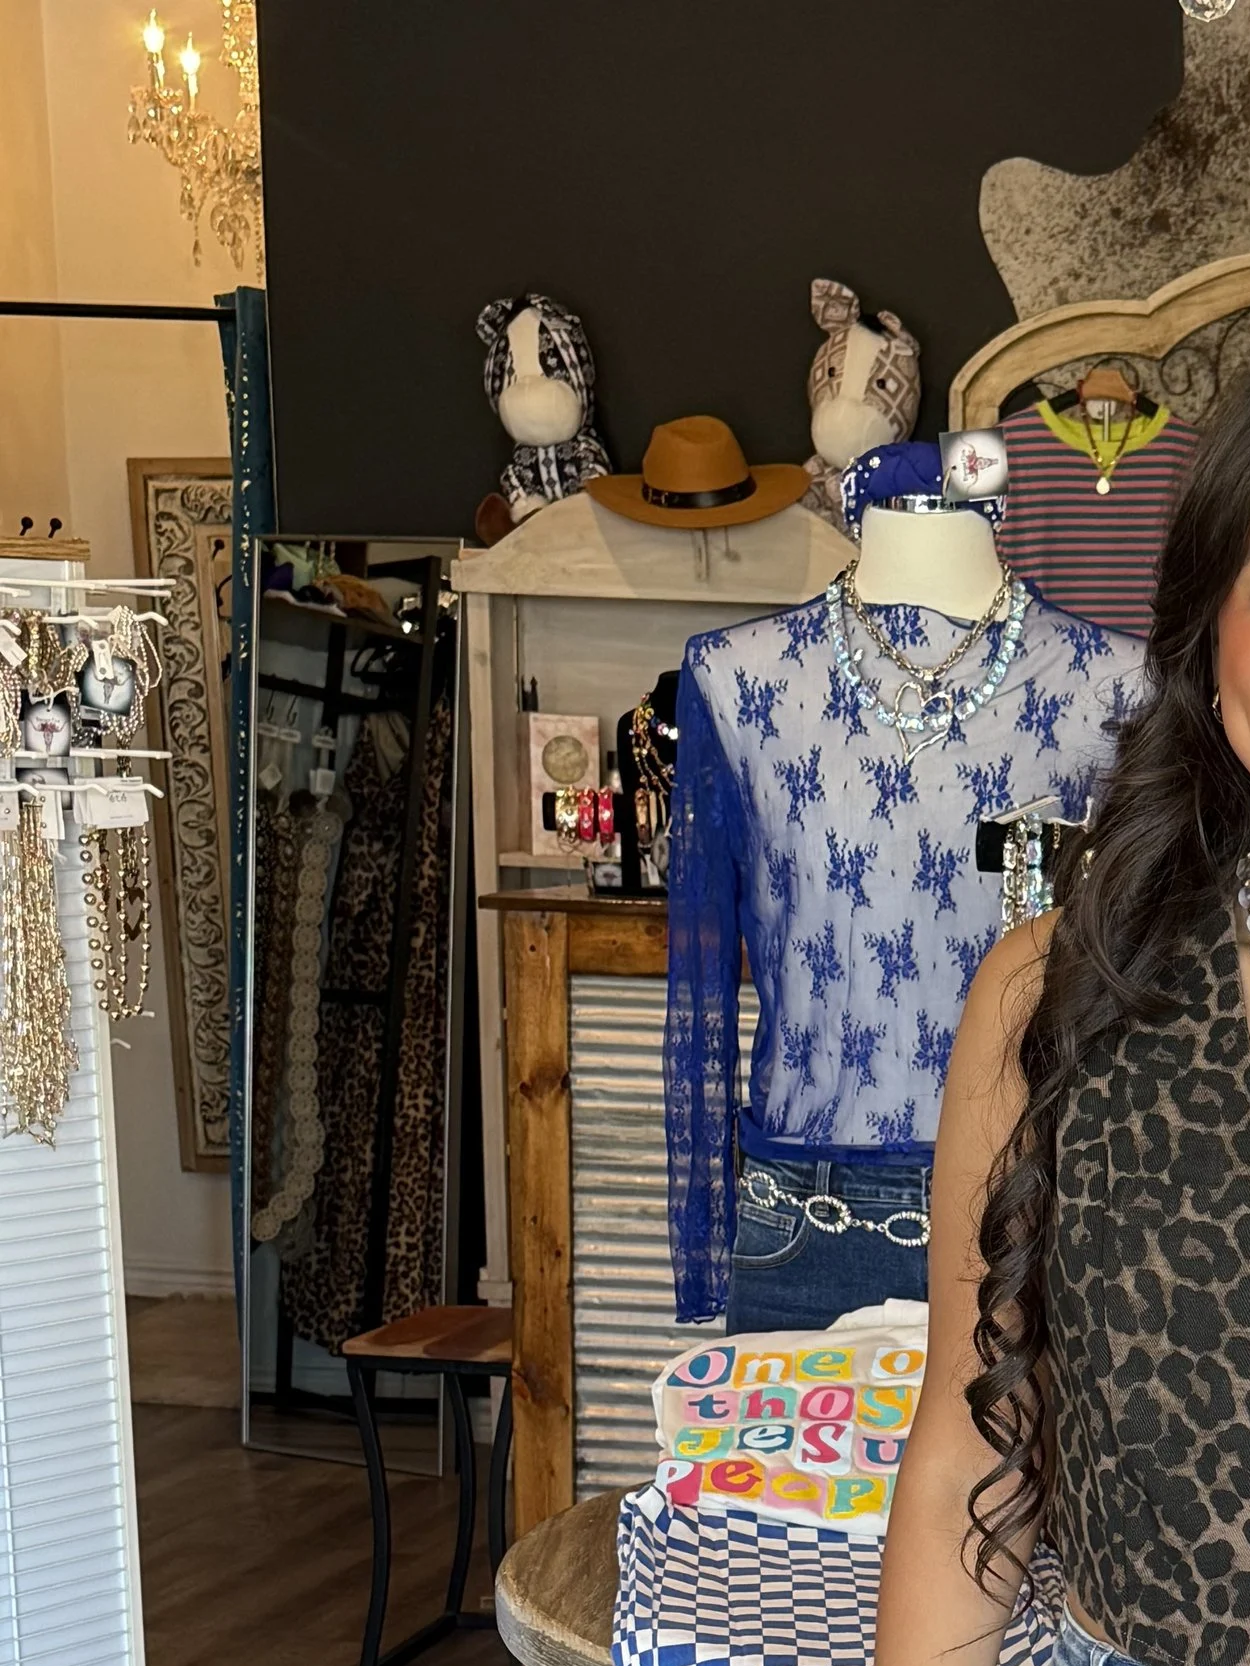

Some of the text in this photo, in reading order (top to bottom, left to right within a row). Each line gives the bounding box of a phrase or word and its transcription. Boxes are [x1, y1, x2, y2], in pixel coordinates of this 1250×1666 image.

[687, 1385, 906, 1429] thos
[677, 1422, 908, 1466] Jesu
[656, 1459, 878, 1514] Peop
